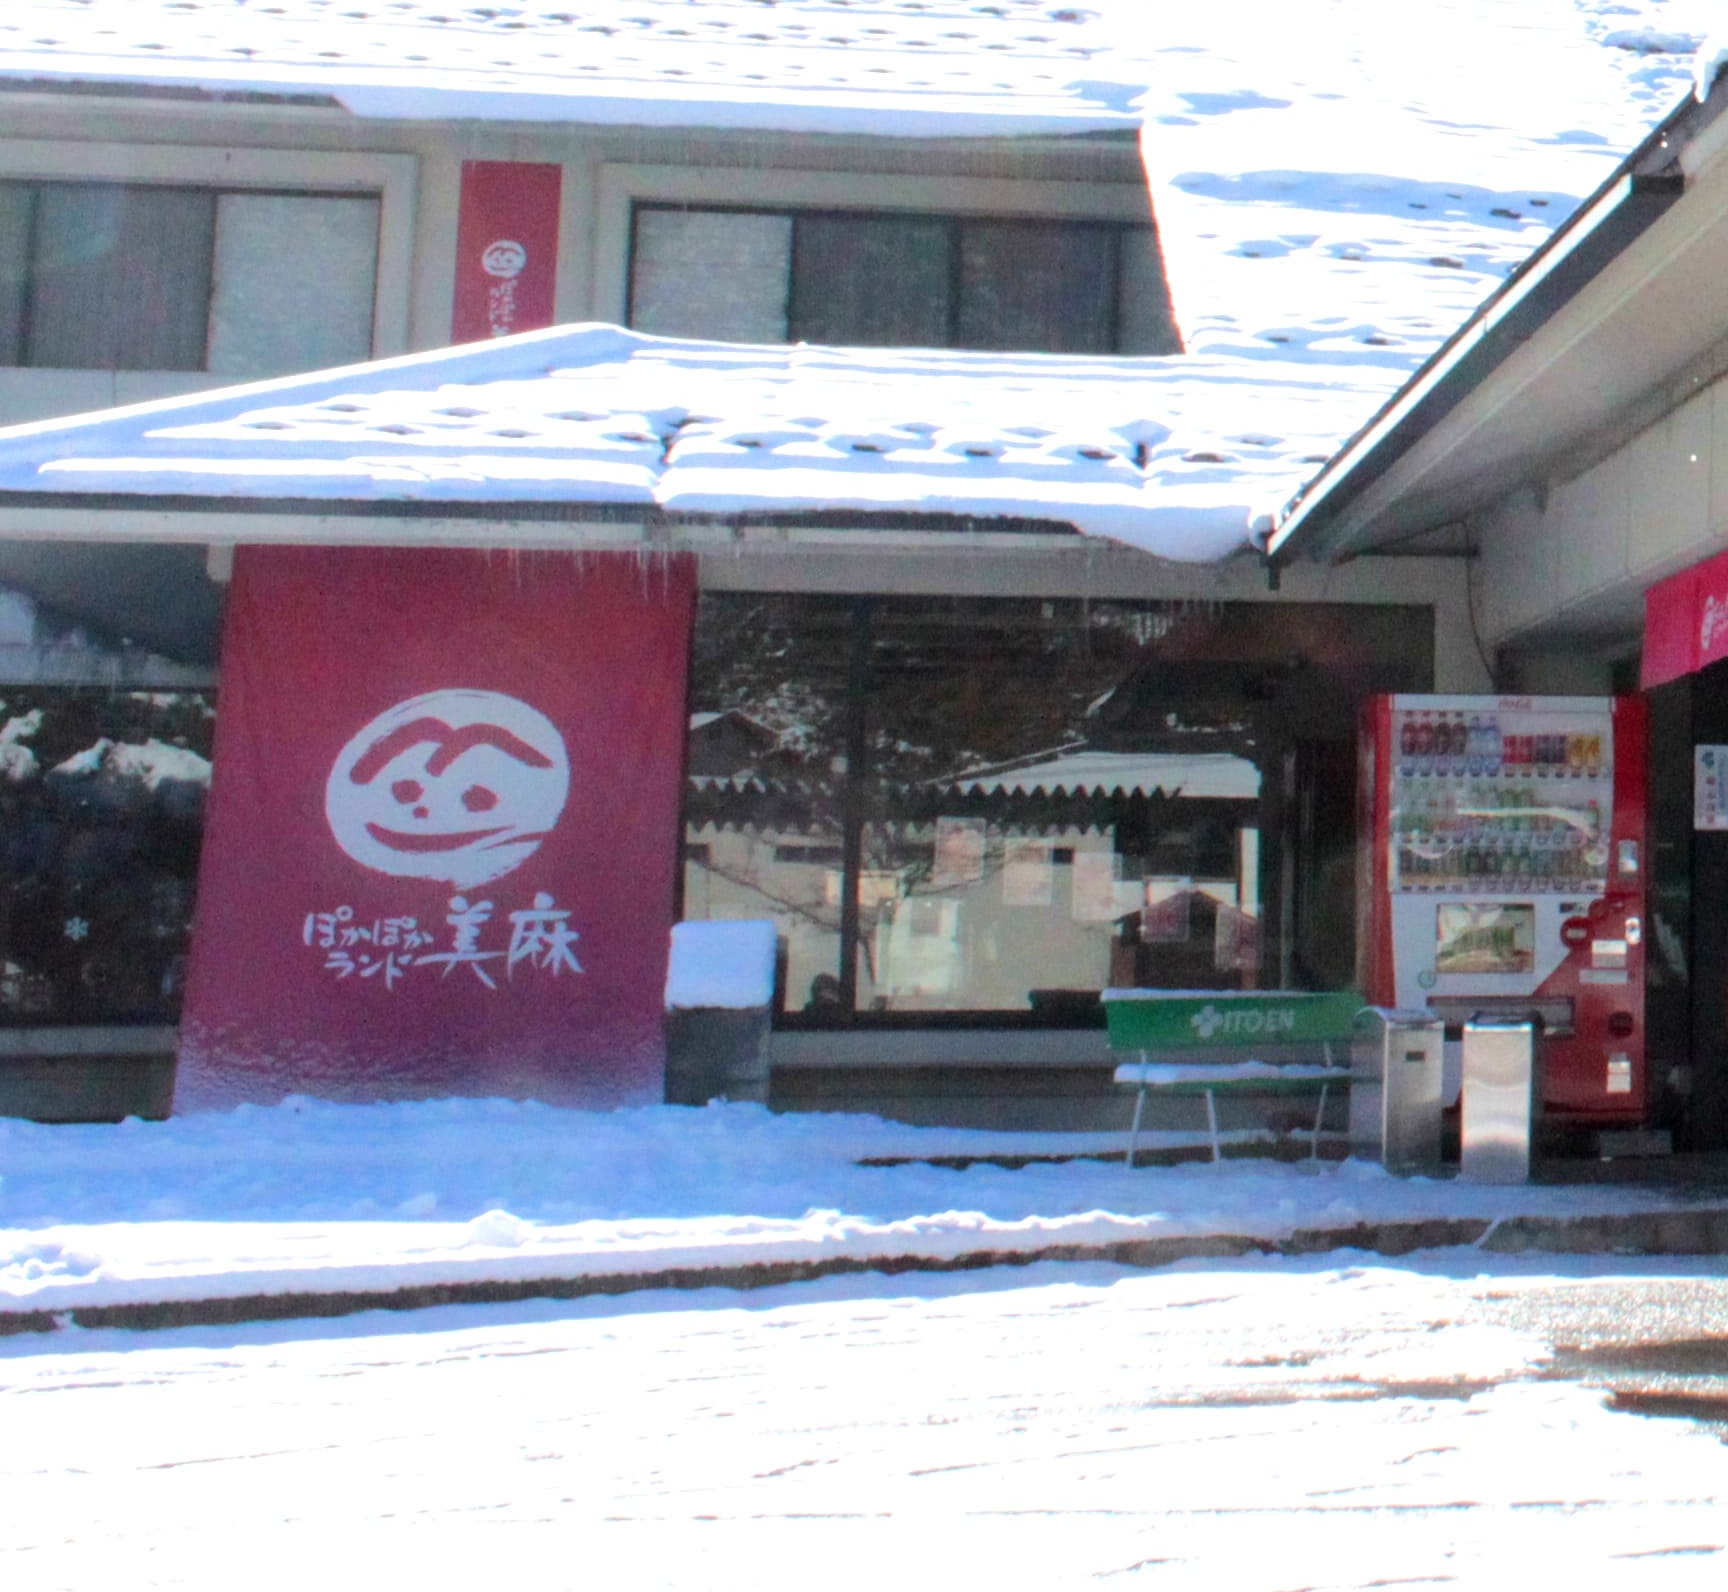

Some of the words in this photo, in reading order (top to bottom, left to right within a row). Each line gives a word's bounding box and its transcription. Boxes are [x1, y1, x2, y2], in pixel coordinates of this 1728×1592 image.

[303, 905, 434, 949] ぽかぽか
[414, 891, 585, 990] 美麻
[324, 951, 413, 991] ランド
